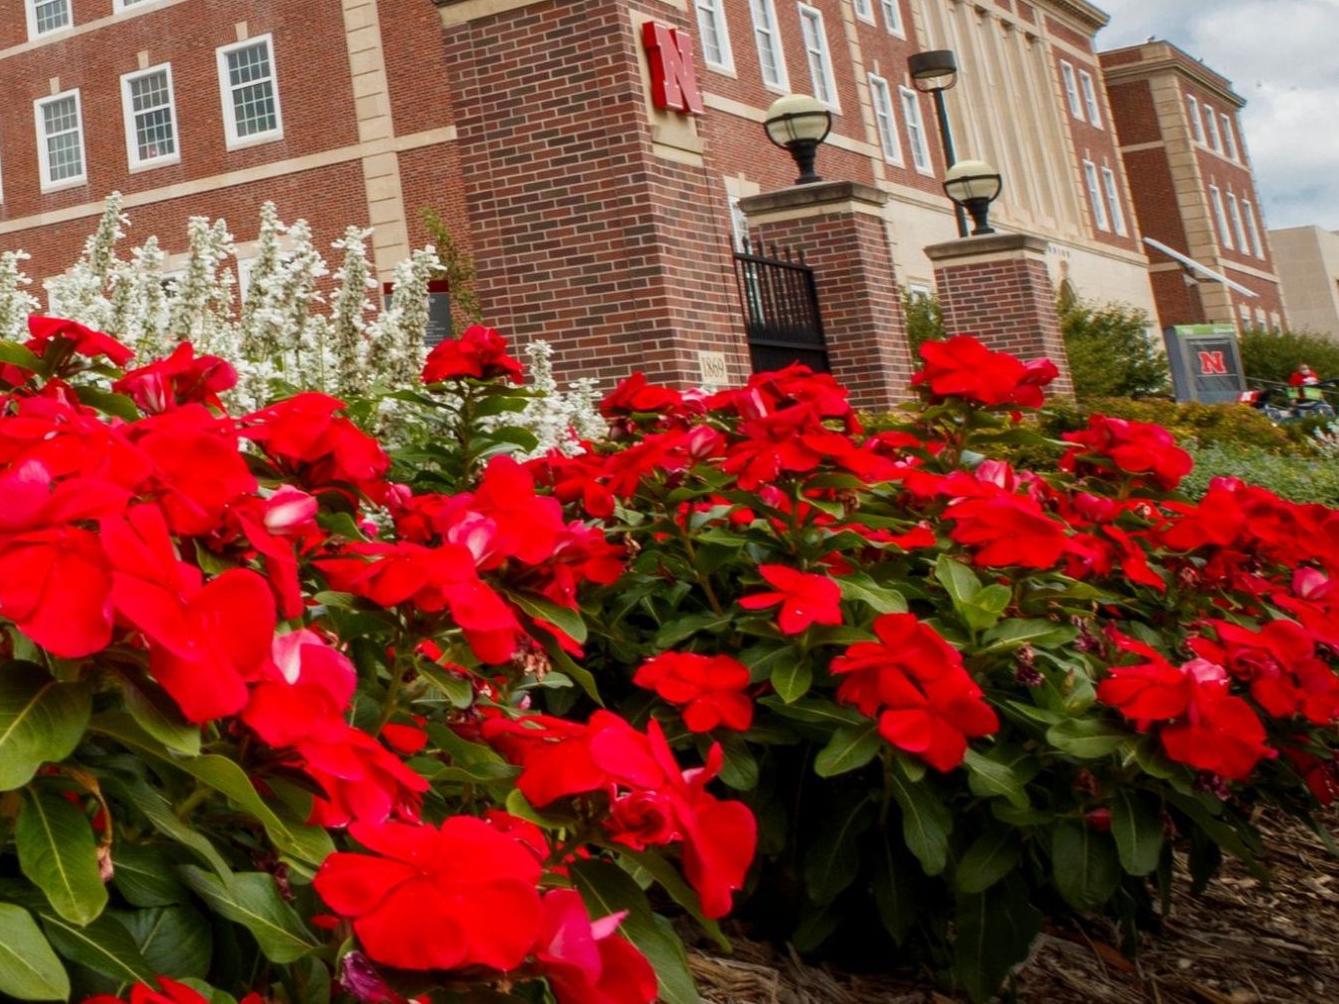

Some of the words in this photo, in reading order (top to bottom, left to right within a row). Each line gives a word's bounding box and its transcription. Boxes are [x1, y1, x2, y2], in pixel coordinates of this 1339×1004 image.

[642, 21, 706, 114] N
[702, 356, 725, 378] 1869
[1198, 350, 1227, 375] N
